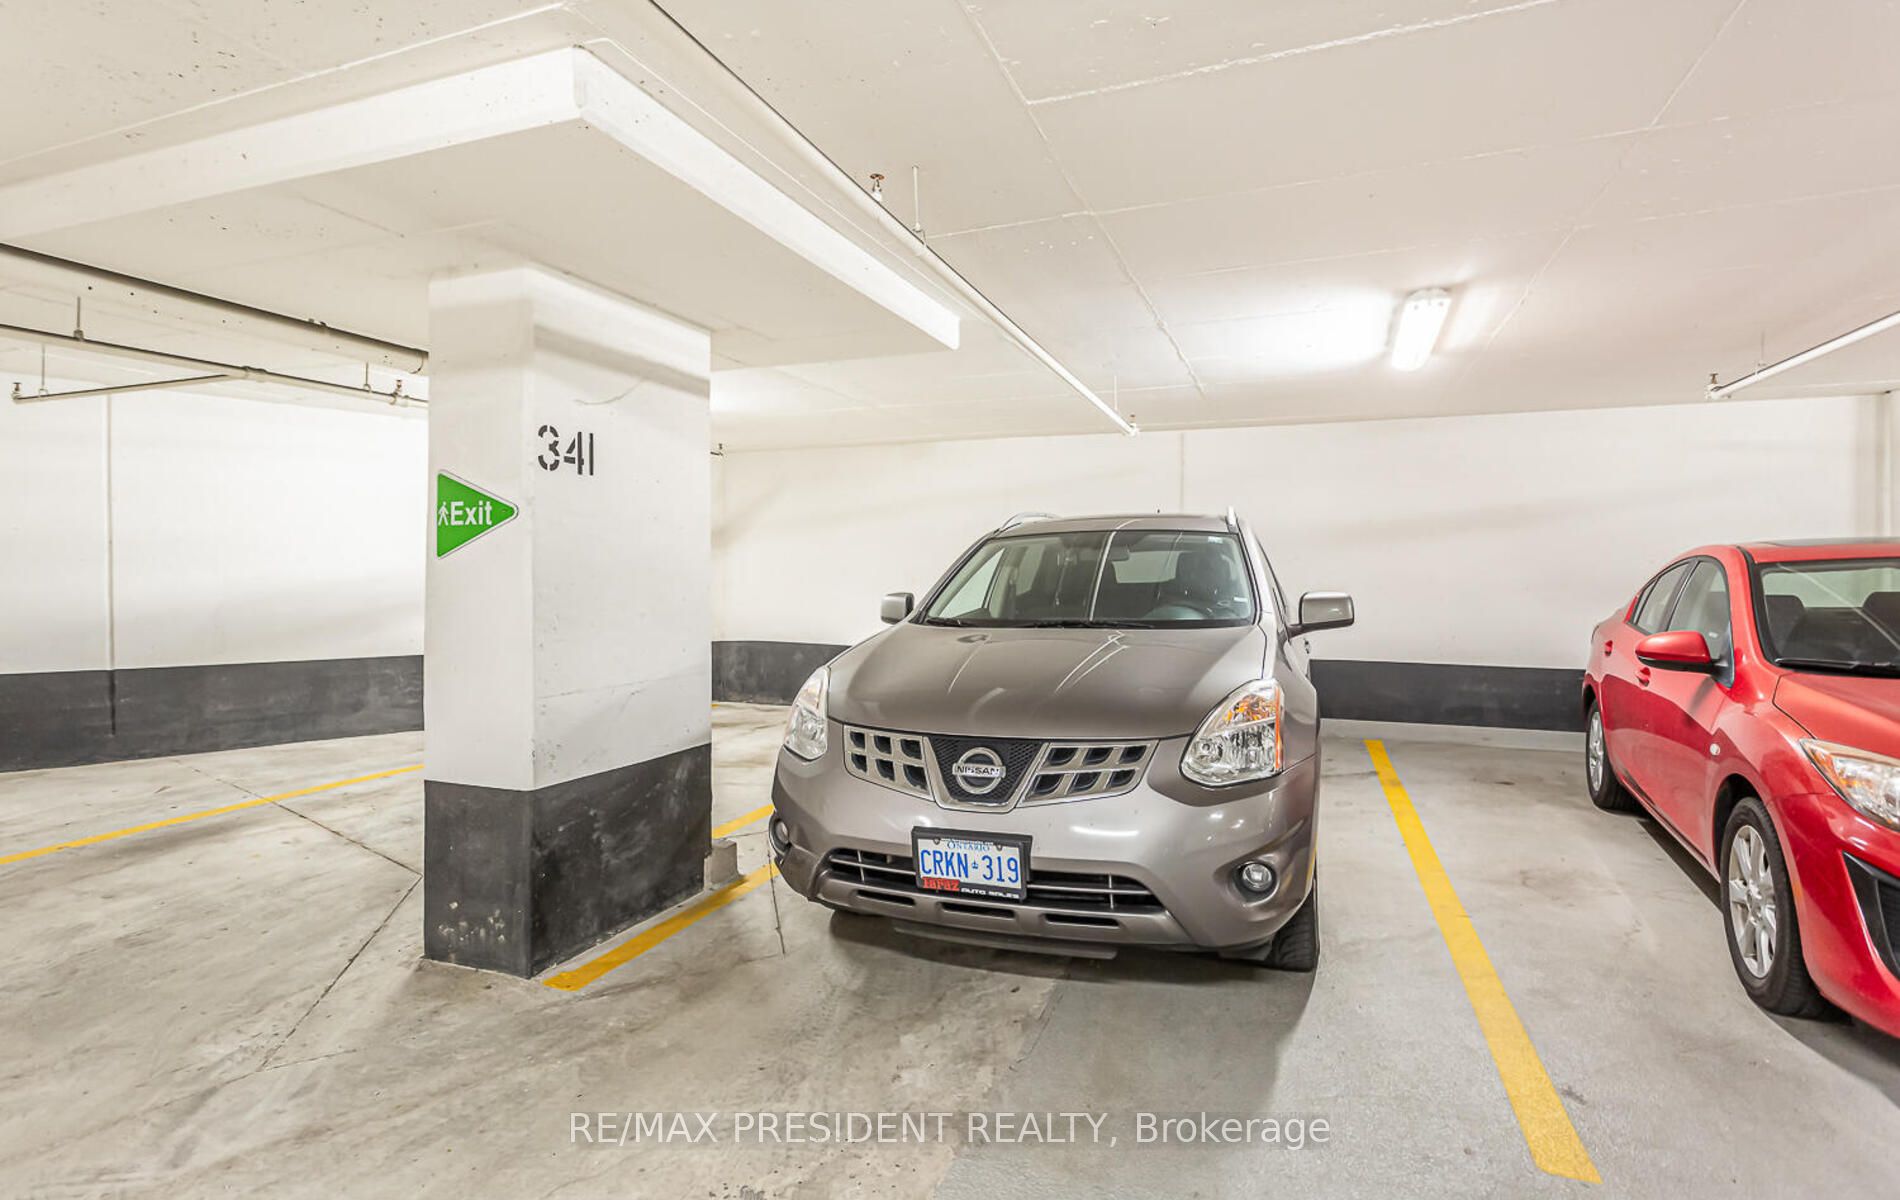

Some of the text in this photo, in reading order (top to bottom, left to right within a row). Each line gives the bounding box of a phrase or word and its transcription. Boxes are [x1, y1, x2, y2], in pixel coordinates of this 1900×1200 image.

[537, 424, 594, 476] 341
[450, 500, 492, 526] Exit
[957, 765, 1000, 776] NISSAN
